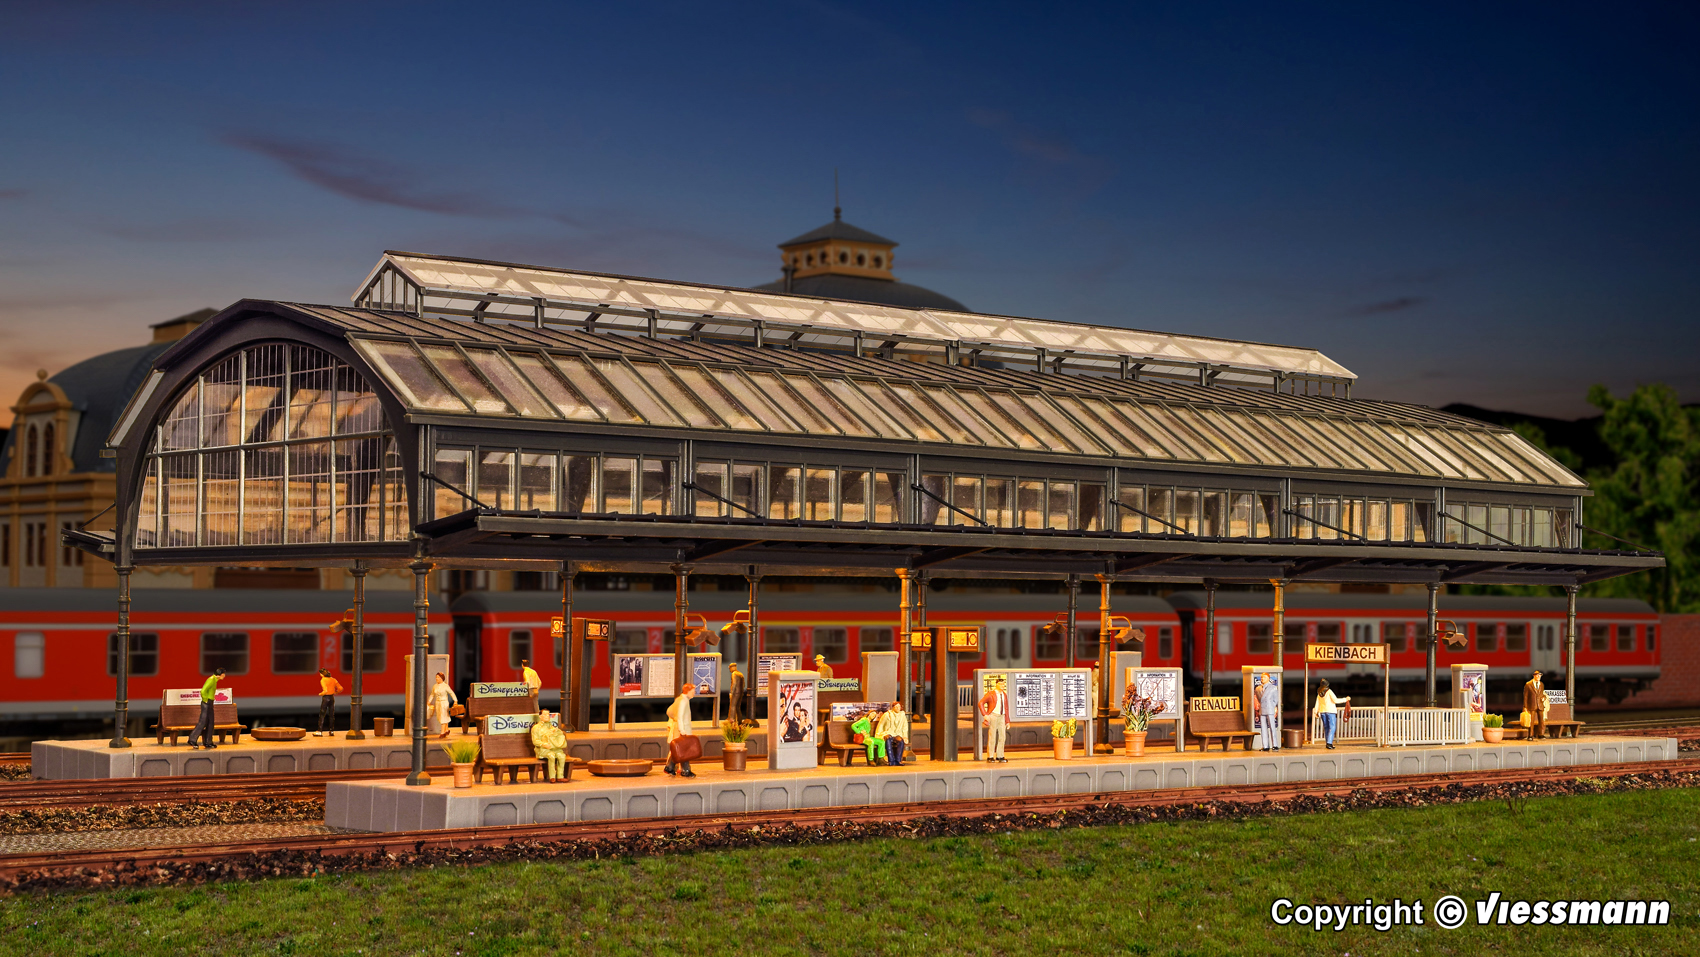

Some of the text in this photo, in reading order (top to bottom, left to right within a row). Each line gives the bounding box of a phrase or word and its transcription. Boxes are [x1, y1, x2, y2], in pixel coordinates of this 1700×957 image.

[325, 636, 336, 652] 2
[1315, 647, 1377, 659] KIENBACH
[1194, 698, 1238, 711] RENAULT
